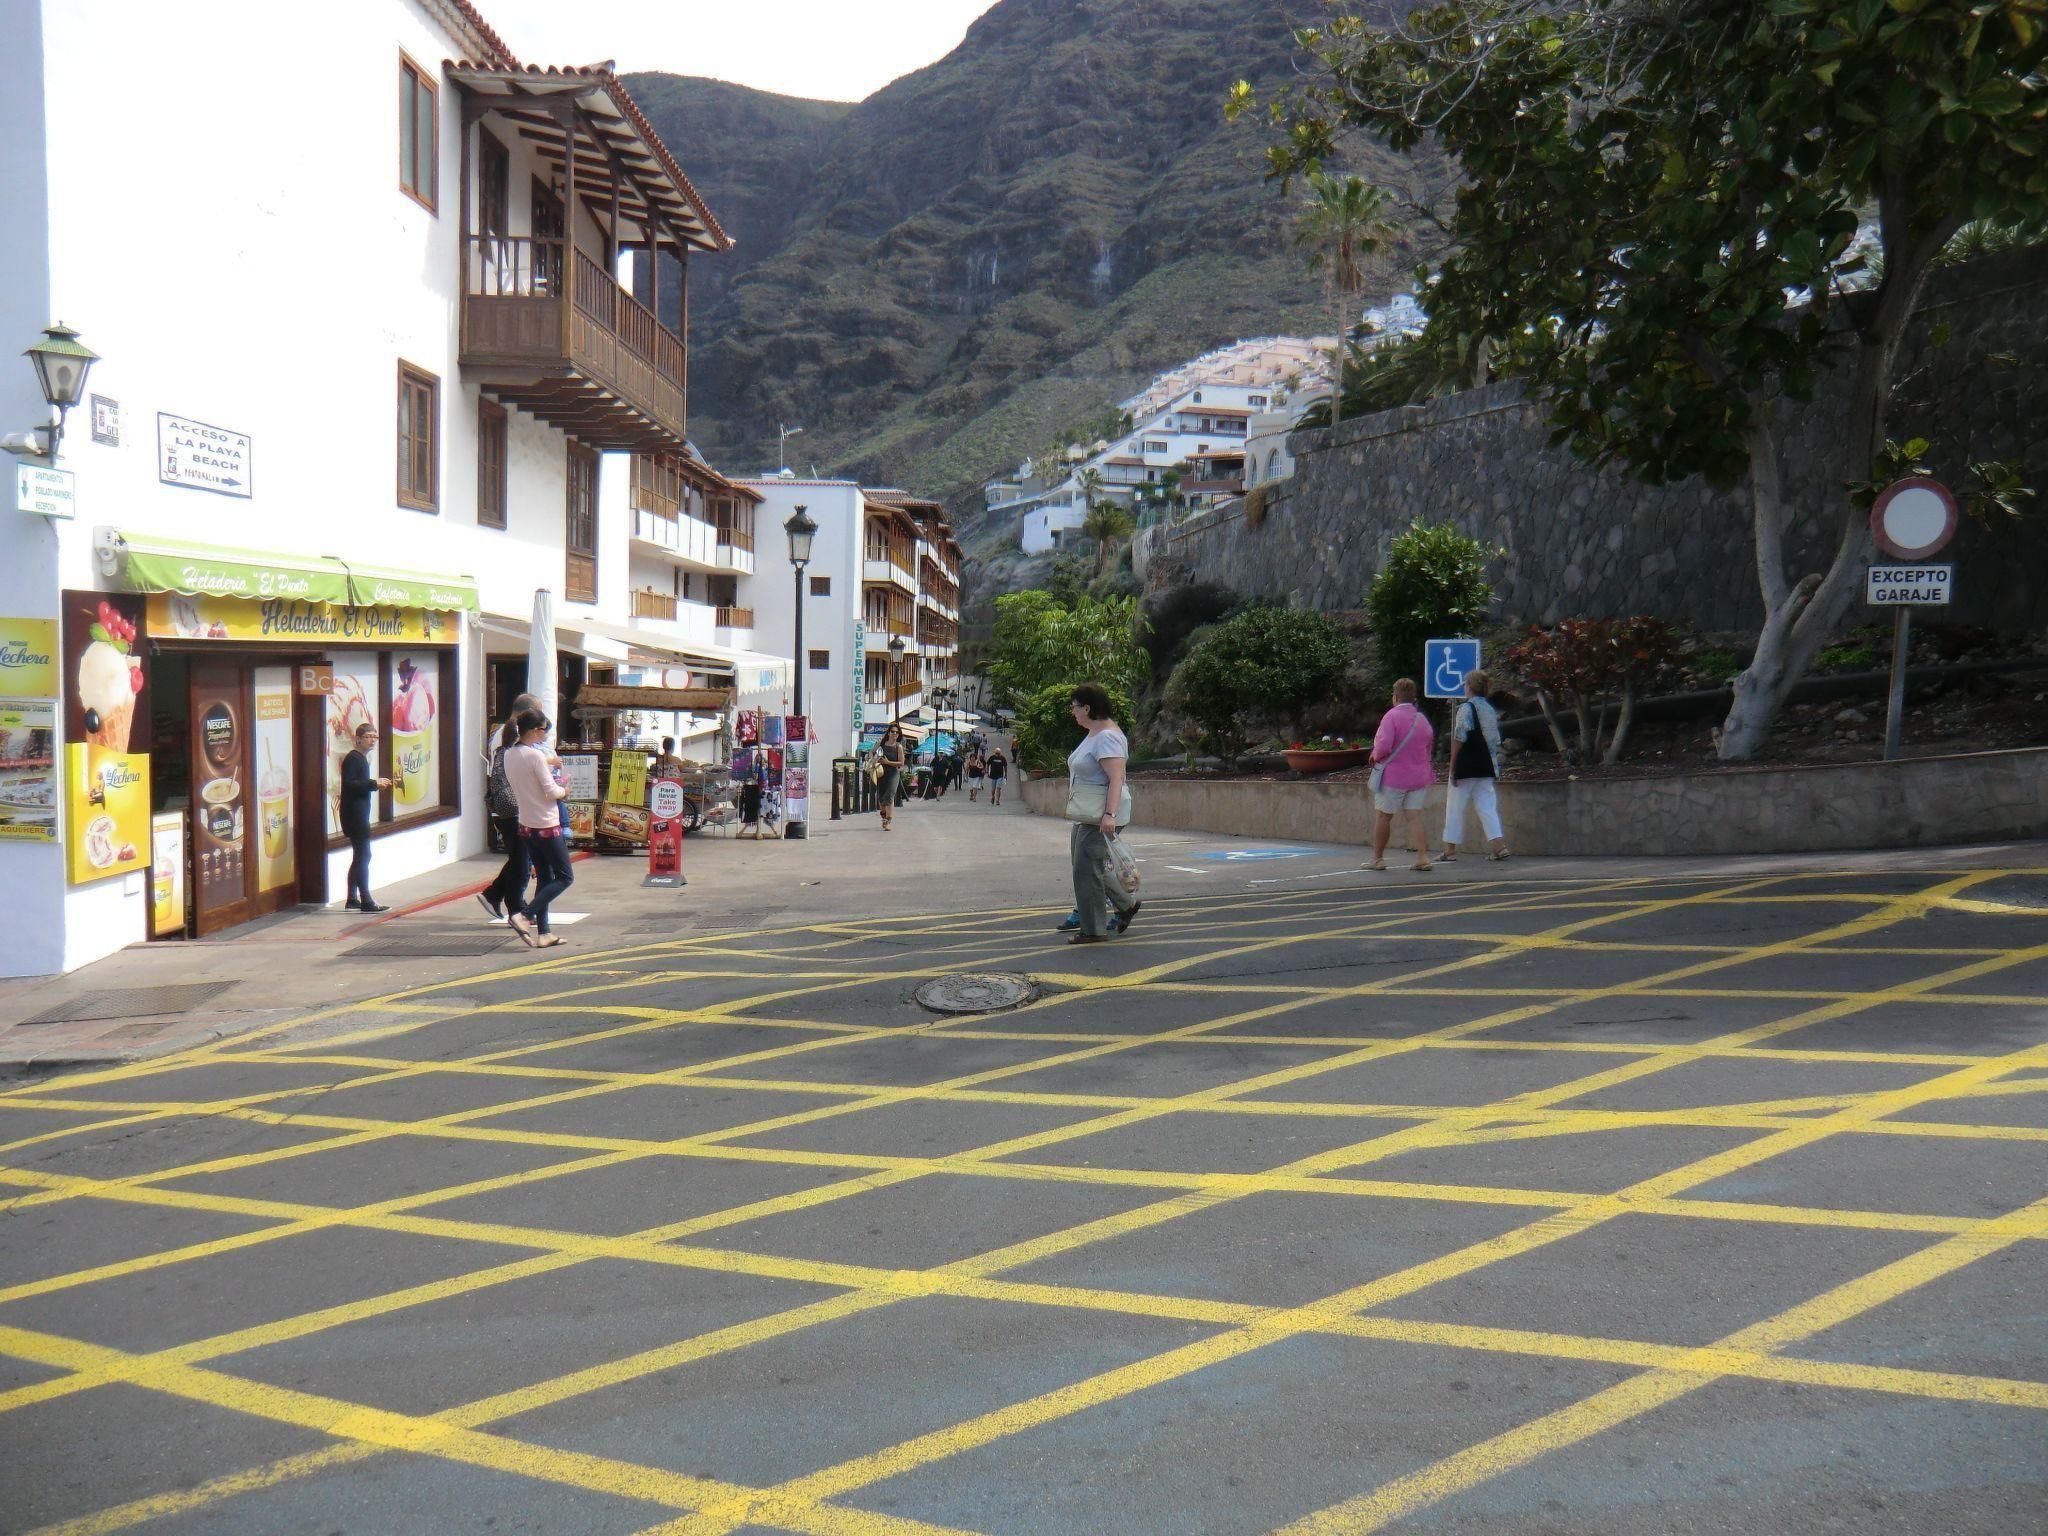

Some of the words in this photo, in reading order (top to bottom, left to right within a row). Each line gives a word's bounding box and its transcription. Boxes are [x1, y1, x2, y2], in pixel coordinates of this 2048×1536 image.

[169, 421, 228, 442] ACCESO
[237, 438, 246, 447] A
[175, 437, 194, 448] LA
[199, 442, 242, 459] PLAYA
[192, 454, 239, 472] BEACH
[1872, 570, 1948, 583] EXCEPTO
[1875, 588, 1942, 601] GARAJE
[342, 605, 360, 637] El
[364, 606, 405, 638] Punto
[853, 623, 864, 729] SUPERMERCADO
[108, 767, 141, 787] Lechera
[619, 772, 636, 783] WINE
